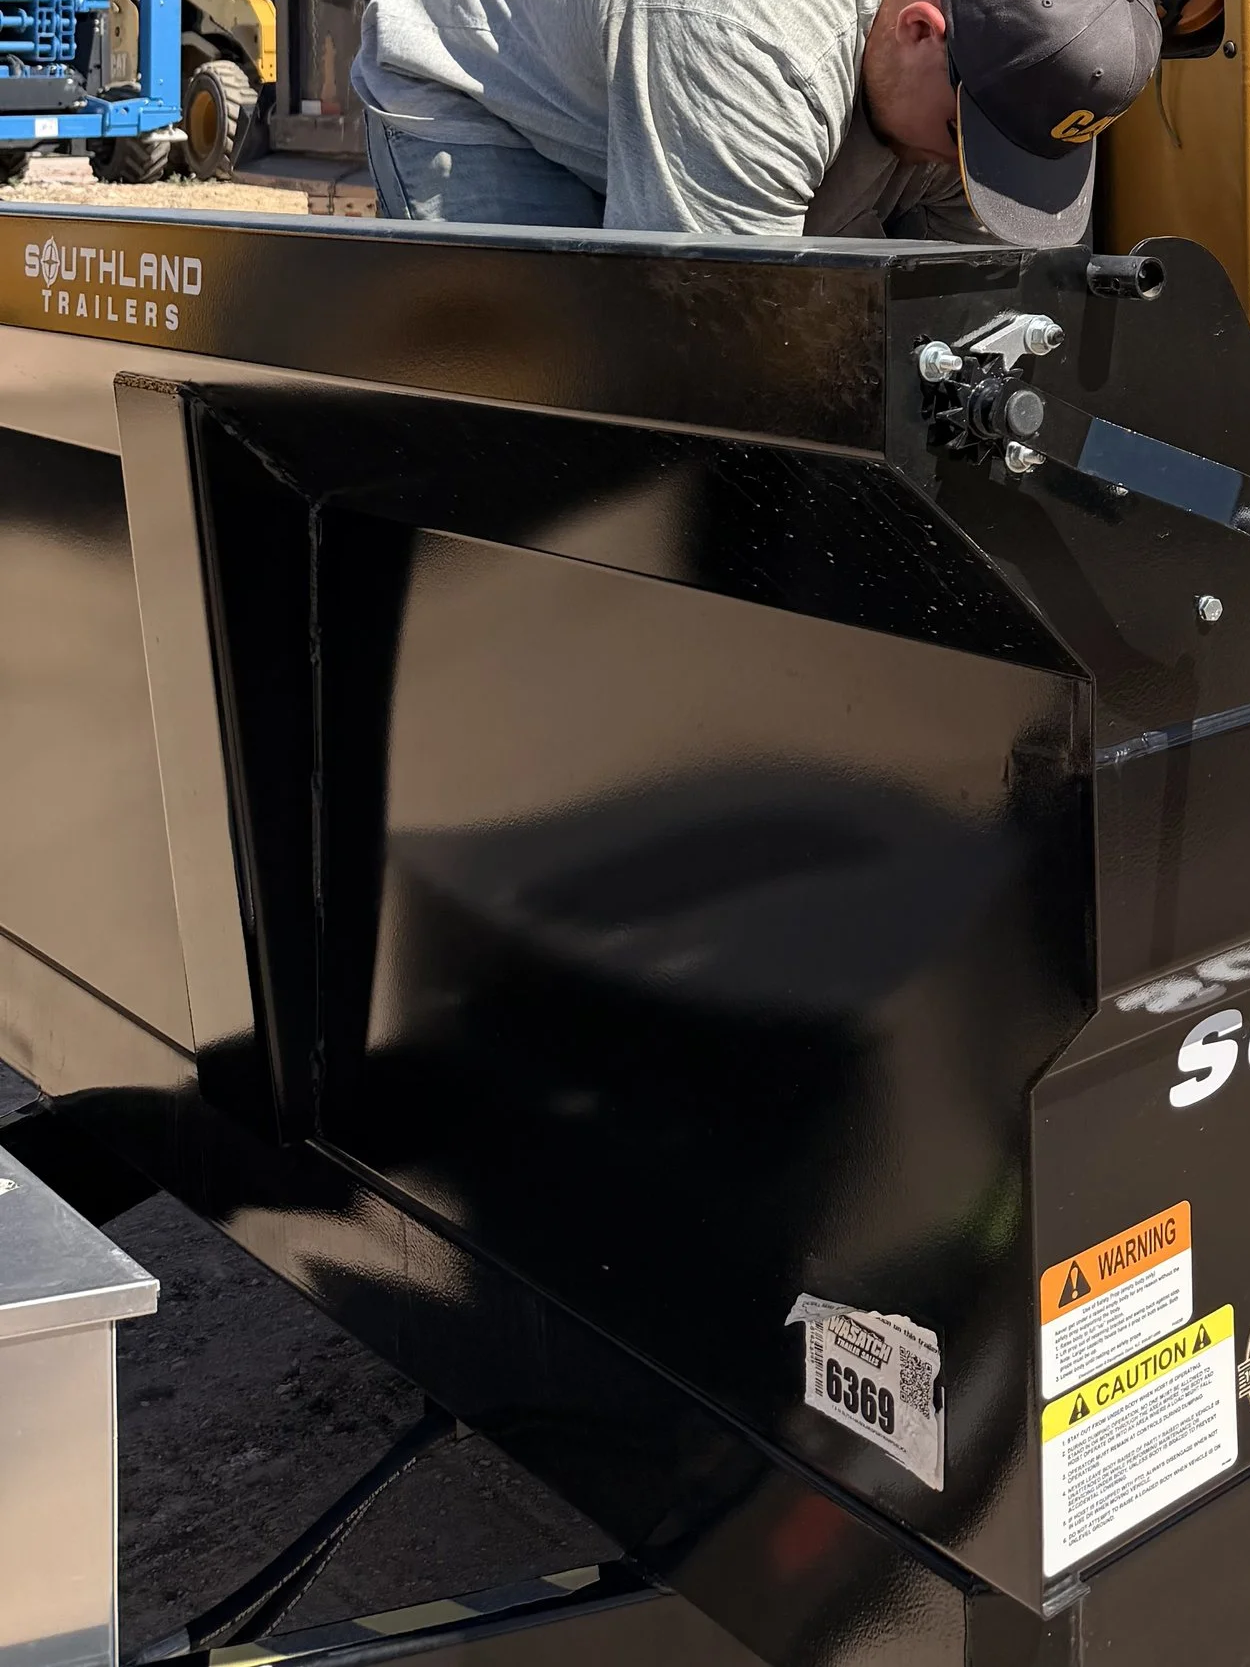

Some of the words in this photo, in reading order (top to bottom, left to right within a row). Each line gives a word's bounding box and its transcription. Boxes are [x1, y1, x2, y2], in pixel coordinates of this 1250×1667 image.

[24, 235, 202, 296] SOUTHLAND
[41, 289, 179, 331] TRAILERS
[1098, 1217, 1176, 1280] WARNING
[827, 1314, 893, 1362] WASATCH
[836, 1339, 859, 1357] TRAILER
[861, 1351, 880, 1367] SALES
[826, 1357, 895, 1435] 6369
[1096, 1338, 1186, 1406] CAUTION
